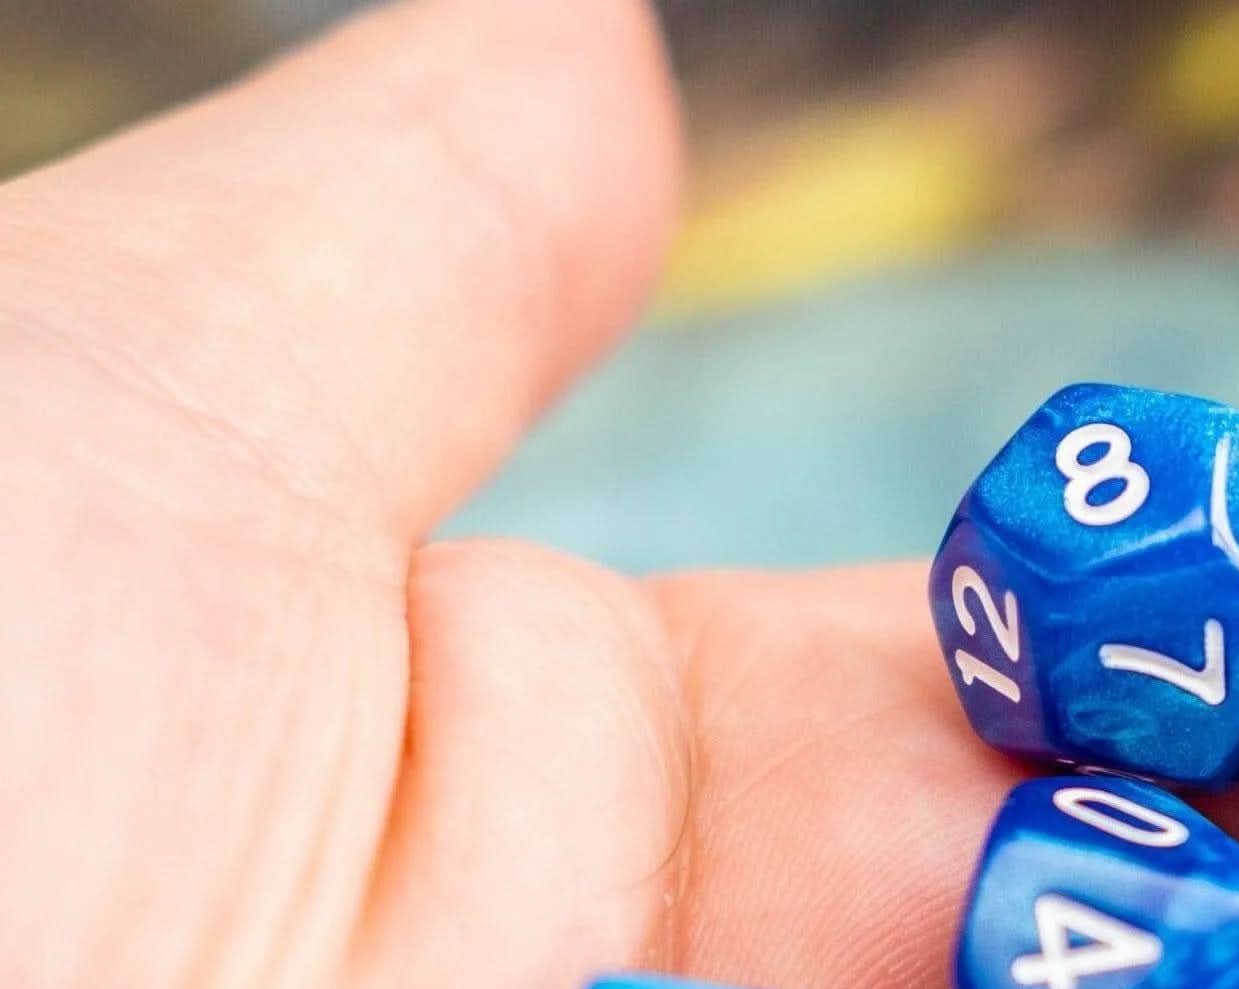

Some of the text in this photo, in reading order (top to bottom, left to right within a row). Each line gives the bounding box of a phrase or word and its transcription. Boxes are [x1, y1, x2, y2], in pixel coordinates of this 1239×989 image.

[1056, 422, 1150, 526] 8
[951, 565, 1021, 704] 12
[1099, 618, 1226, 706] 7
[1053, 787, 1190, 848] 0
